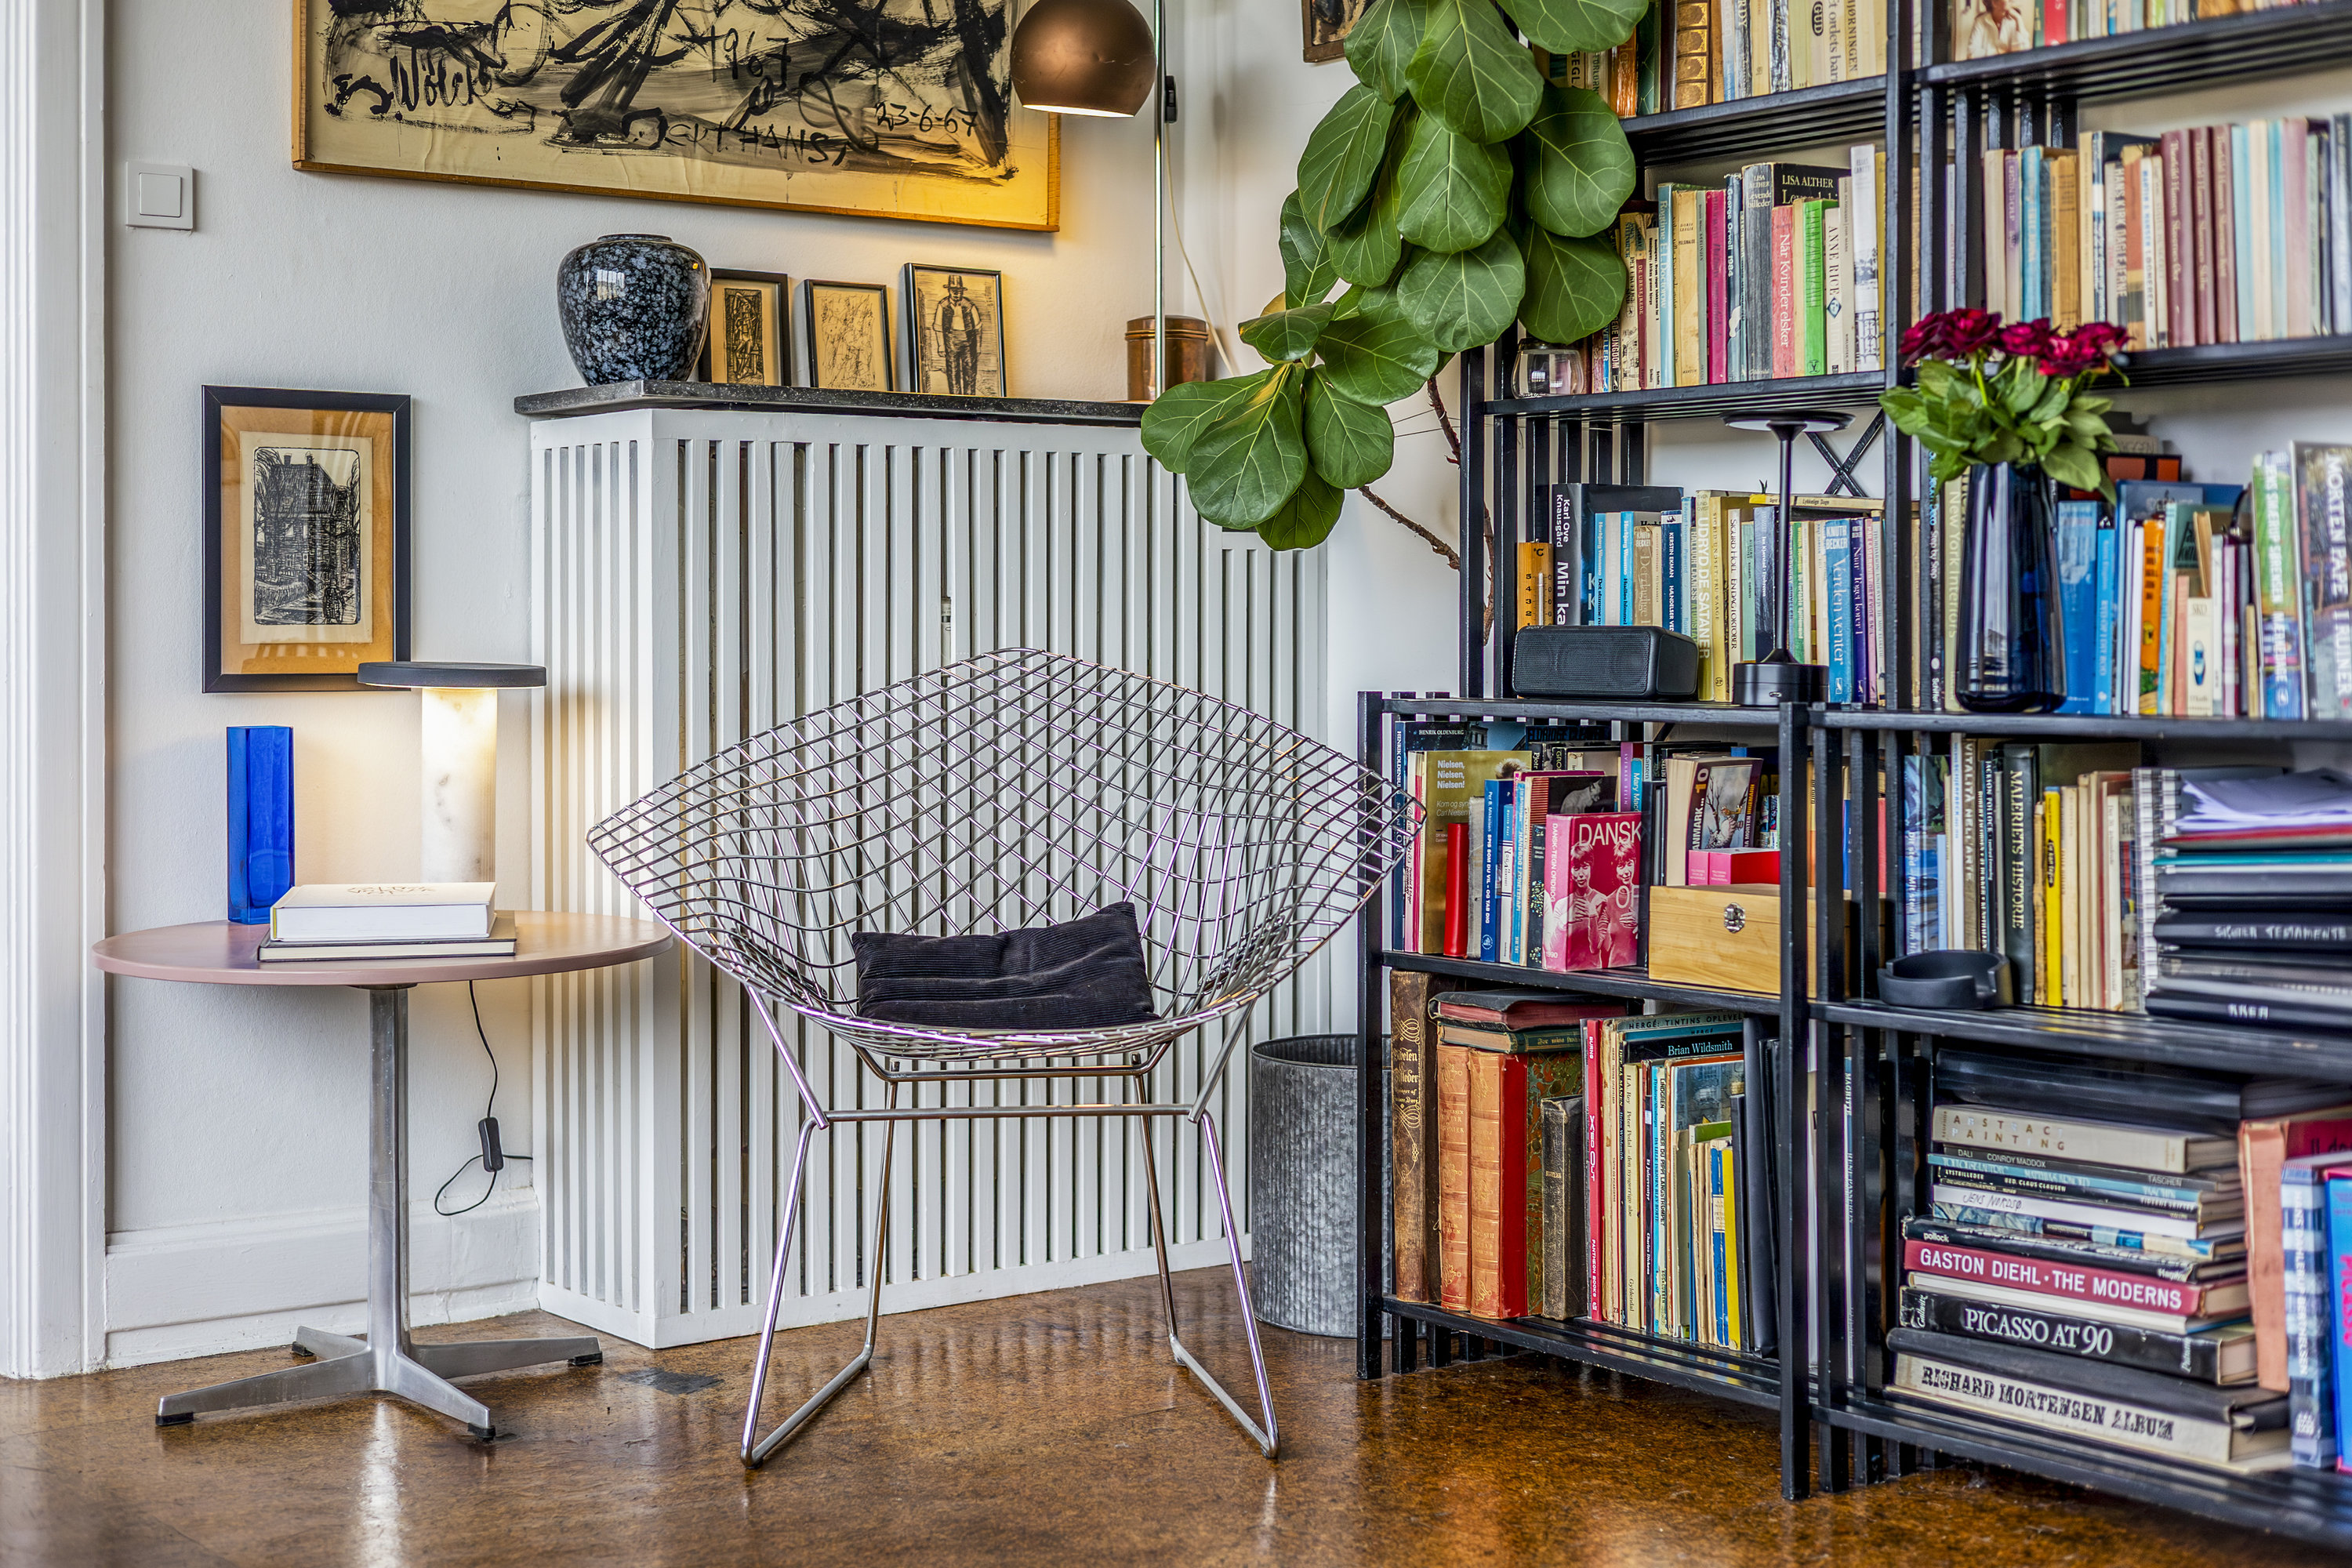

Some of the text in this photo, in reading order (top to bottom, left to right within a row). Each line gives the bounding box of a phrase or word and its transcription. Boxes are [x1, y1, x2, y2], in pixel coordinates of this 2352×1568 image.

[1813, 5, 1823, 33] GUD
[1828, 12, 1841, 53] ordets
[875, 102, 977, 136] 23-6-67
[1782, 175, 1834, 188] LISA ALTHER
[1659, 201, 1668, 240] Ragtime
[2115, 168, 2128, 298] HANS KIRK DAGLEJERNE
[1828, 227, 1839, 296] ANNE RICE
[1780, 234, 1790, 347] Når Kvinder elsker
[2265, 464, 2278, 490] JENS
[1825, 525, 1847, 537] KNUTH
[1929, 530, 1939, 548] Step
[1825, 538, 1847, 550] BECKER
[1929, 549, 1939, 560] by
[1929, 561, 1939, 579] Step
[1948, 491, 1960, 638] New York Interiors
[2269, 546, 2283, 604] SØRENSEN
[2326, 454, 2352, 696] MORTEN PAPE I RUINER
[1557, 561, 1569, 597] Min
[1698, 517, 1709, 659] UDRYD DE SATANER
[1852, 576, 1863, 601] Toget
[1832, 557, 1846, 666] Verden venter
[1437, 760, 1465, 769] Nielsen,
[1437, 771, 1465, 779] Nielsen,
[1695, 768, 1709, 793] 10
[1436, 808, 1448, 817] Carl
[1453, 801, 1460, 810] og
[1965, 742, 1975, 882] VITALITÀ NELL'ARTE
[1579, 821, 1642, 847] DANSK
[2009, 770, 2024, 929] MALERIETS HISTORIE
[1486, 864, 1491, 873] DU
[1485, 889, 1490, 898] OG
[1629, 1017, 1700, 1029] HERGÉ: TINTINS
[1668, 1040, 1733, 1056] Brian Wildsmith
[1951, 1127, 2065, 1150] PAINTING
[1660, 1149, 1665, 1157] DU
[1958, 1149, 1973, 1158] DALI
[1987, 1152, 2016, 1164] CONROY
[2016, 1156, 2046, 1168] MADDOX
[2018, 1179, 2038, 1188] CLAUS
[1923, 1231, 1950, 1243] pollock
[1919, 1248, 2182, 1311] GASTON DIEHL THE MODERNS
[1964, 1308, 2114, 1356] PICASSO AT 90
[1921, 1366, 2175, 1441] RICHARD MORTENSEN ALBUM
